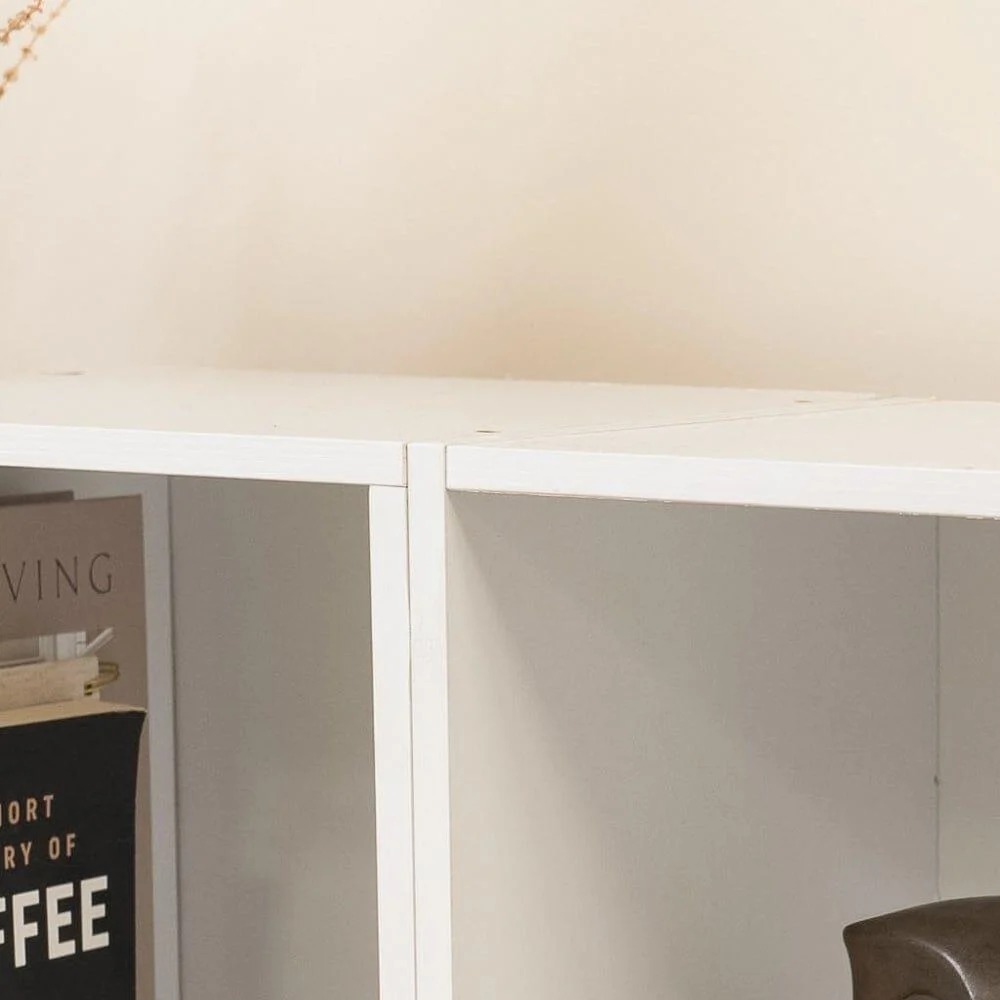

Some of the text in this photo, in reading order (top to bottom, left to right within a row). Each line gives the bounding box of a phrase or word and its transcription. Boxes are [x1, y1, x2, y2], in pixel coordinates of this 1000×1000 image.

[2, 552, 113, 602] VING
[0, 794, 54, 827] ORT
[49, 833, 76, 860] OF
[0, 875, 109, 968] FEE
